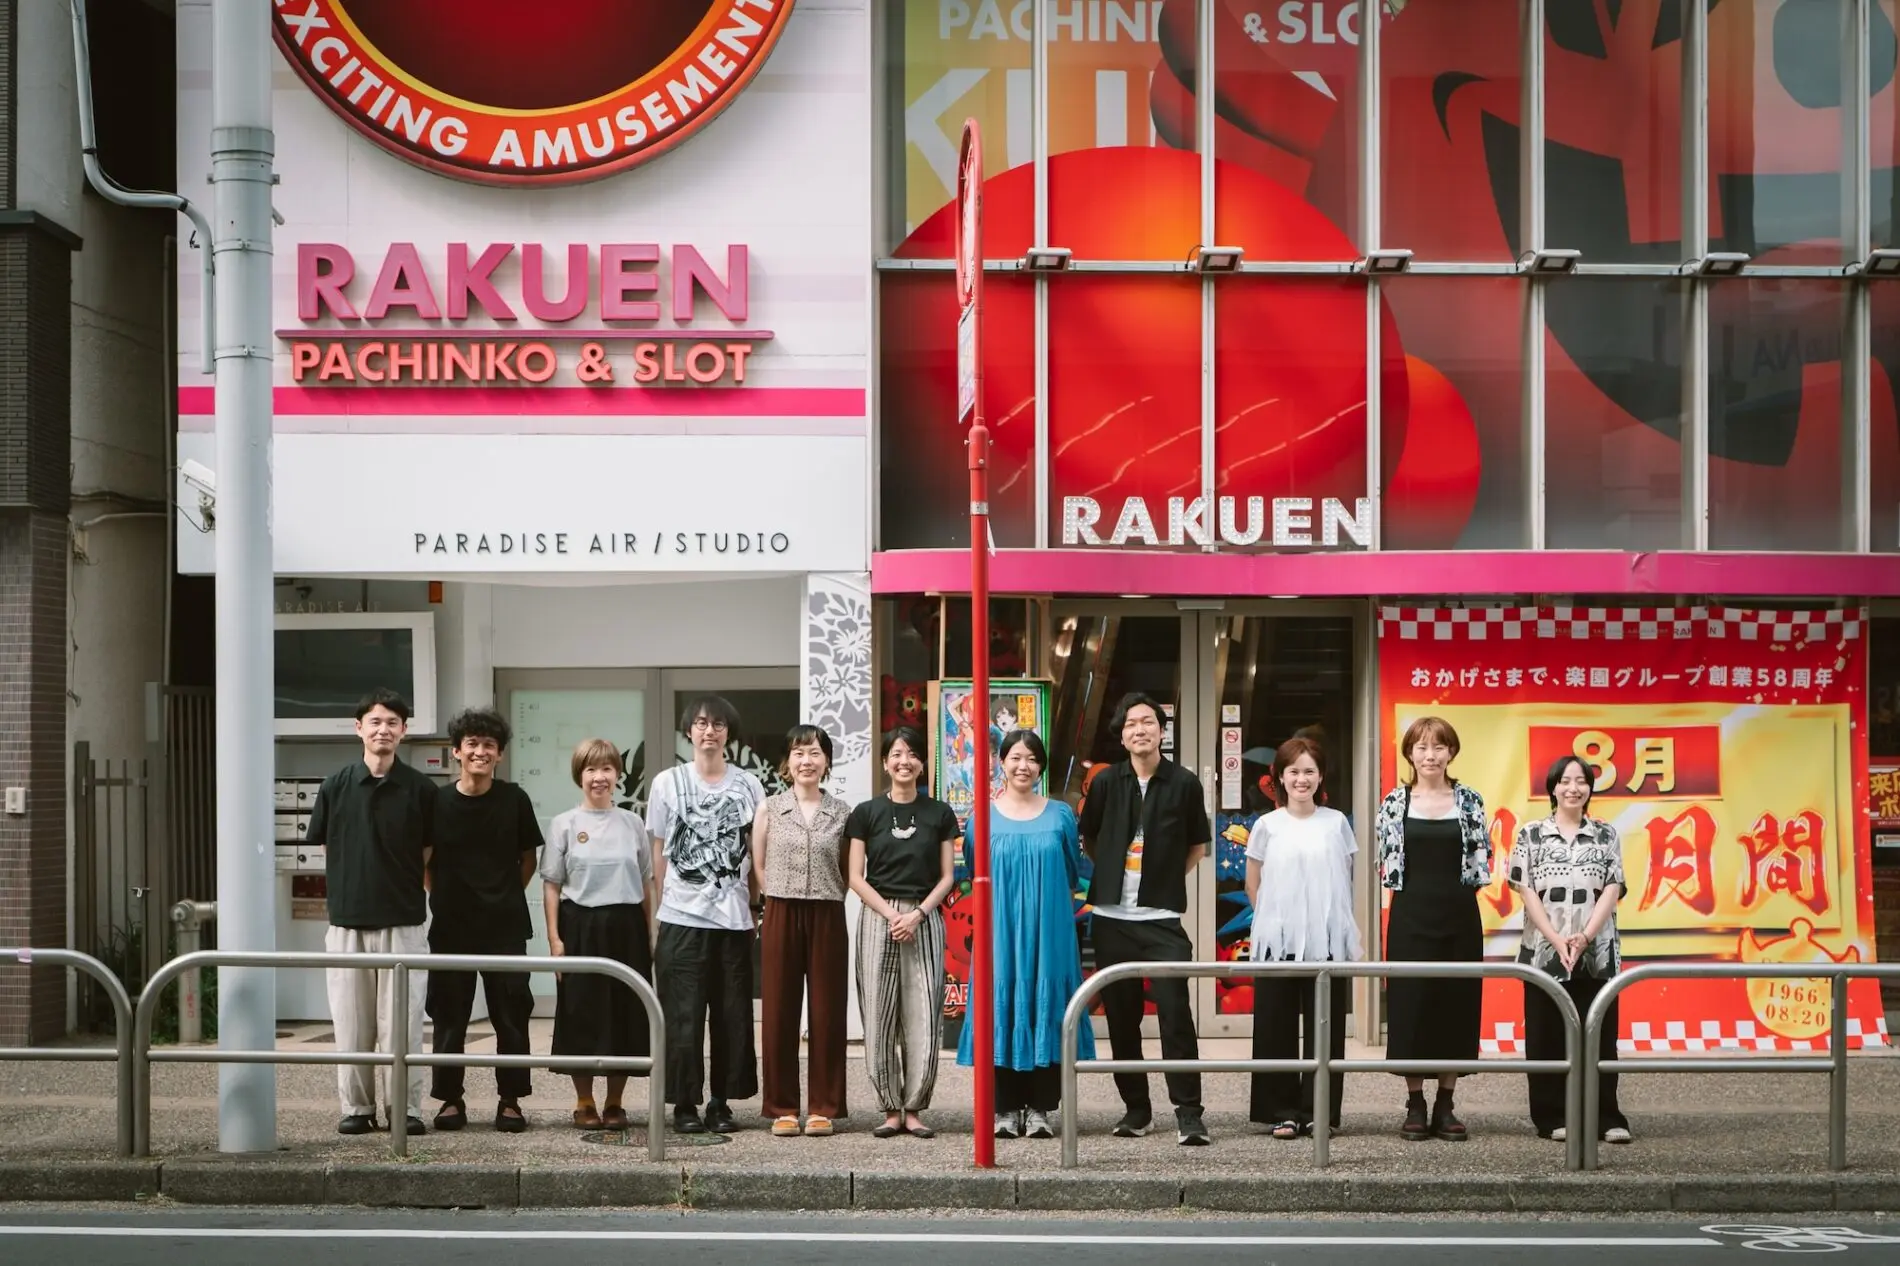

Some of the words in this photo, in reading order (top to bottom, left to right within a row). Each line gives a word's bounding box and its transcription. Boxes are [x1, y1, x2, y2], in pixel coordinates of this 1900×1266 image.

[939, 0, 1161, 42] PACHIN
[1243, 12, 1270, 43] &
[1277, 0, 1394, 45] SLO
[274, 0, 468, 156] XCITING
[297, 243, 748, 322] RAKUEN
[292, 341, 558, 382] PACHINKO
[576, 341, 616, 382] &
[634, 342, 752, 383] SLOT
[1063, 496, 1371, 545] RAKUEN
[414, 533, 568, 553] PARADISE
[589, 533, 637, 553] AIR
[675, 533, 789, 553] STUDIO
[275, 601, 344, 613] ARADISE
[1411, 665, 1834, 688] おかげさまで、楽園グループ創業58周年
[1572, 730, 1676, 793] 8月
[1769, 981, 1826, 1006] 1966.
[1765, 1003, 1826, 1028] 08.20
